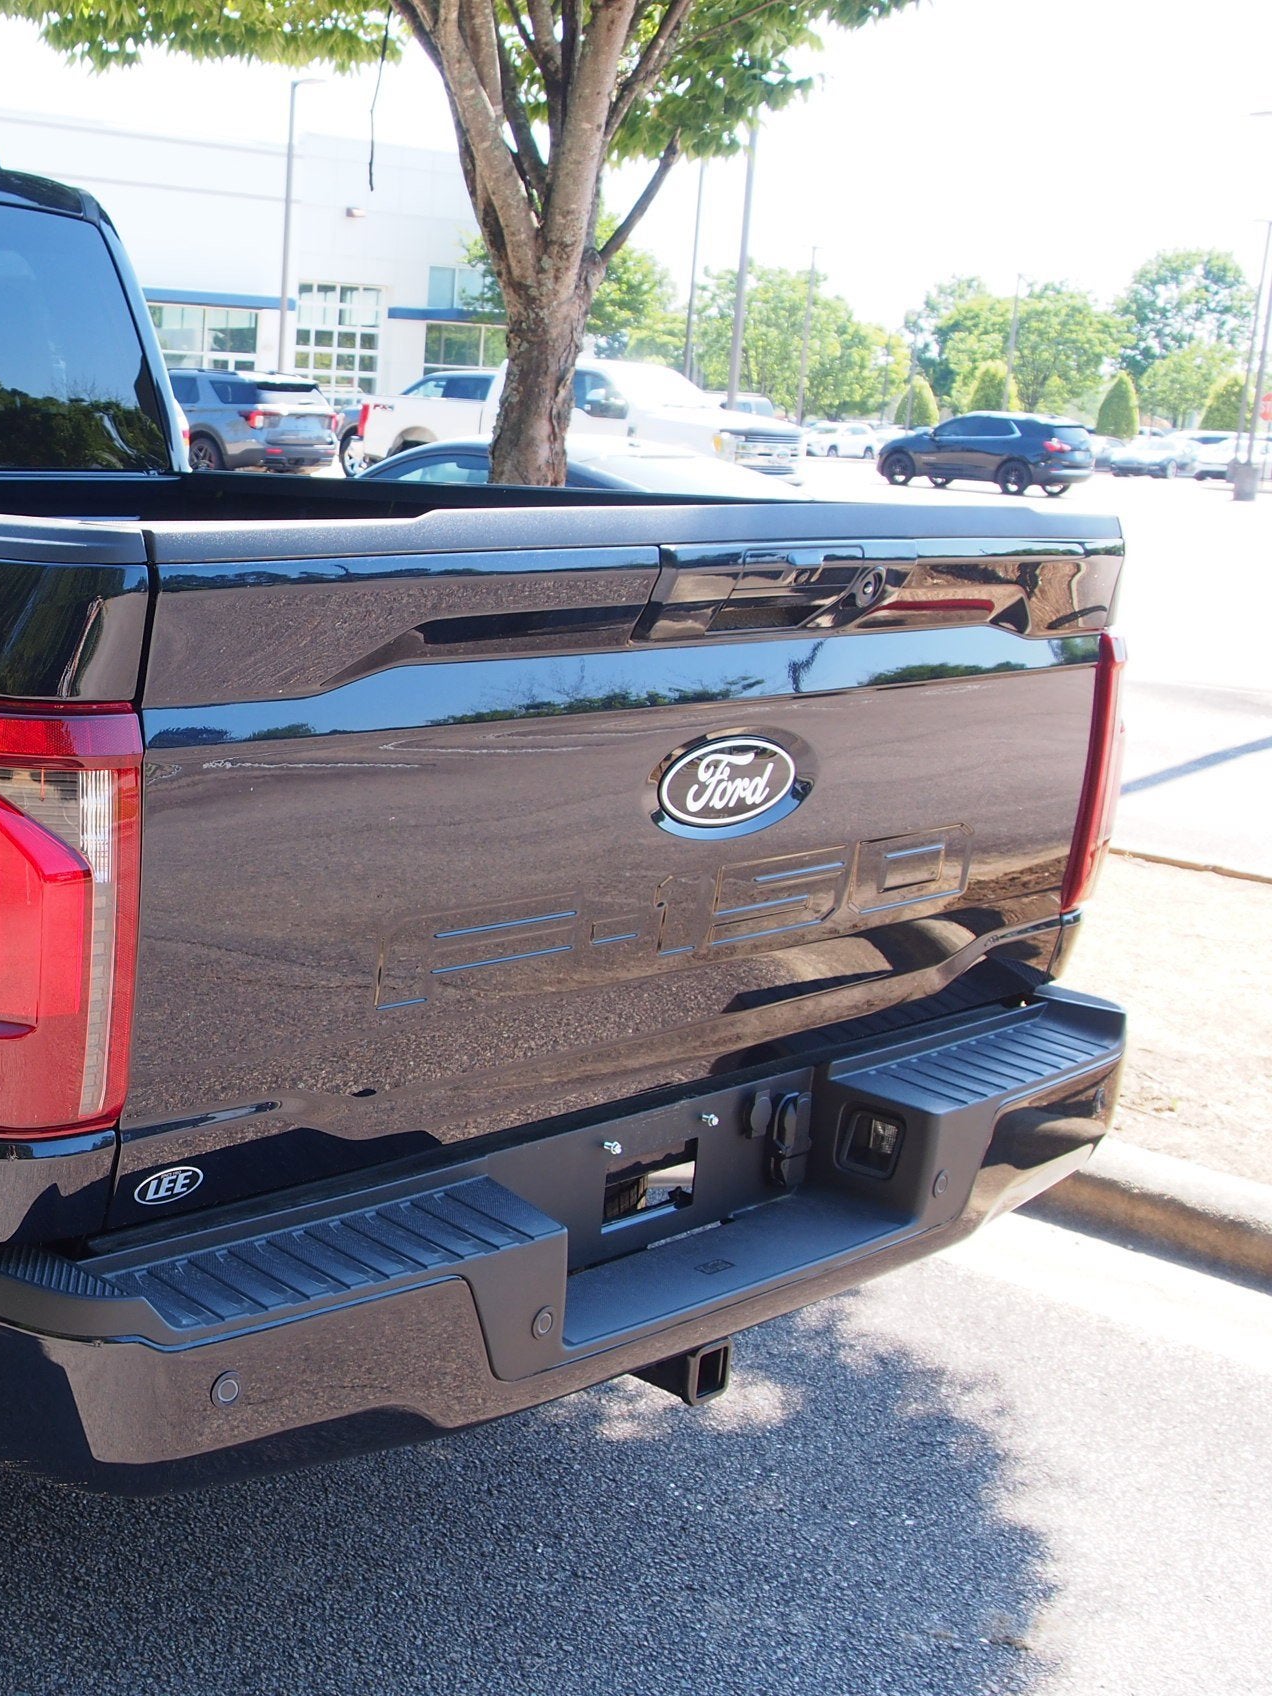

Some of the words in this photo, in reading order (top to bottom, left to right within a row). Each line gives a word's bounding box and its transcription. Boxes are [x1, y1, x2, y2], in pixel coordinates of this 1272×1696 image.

[686, 753, 774, 812] Ford
[374, 822, 974, 1010] F-150
[145, 1171, 192, 1200] LEE
